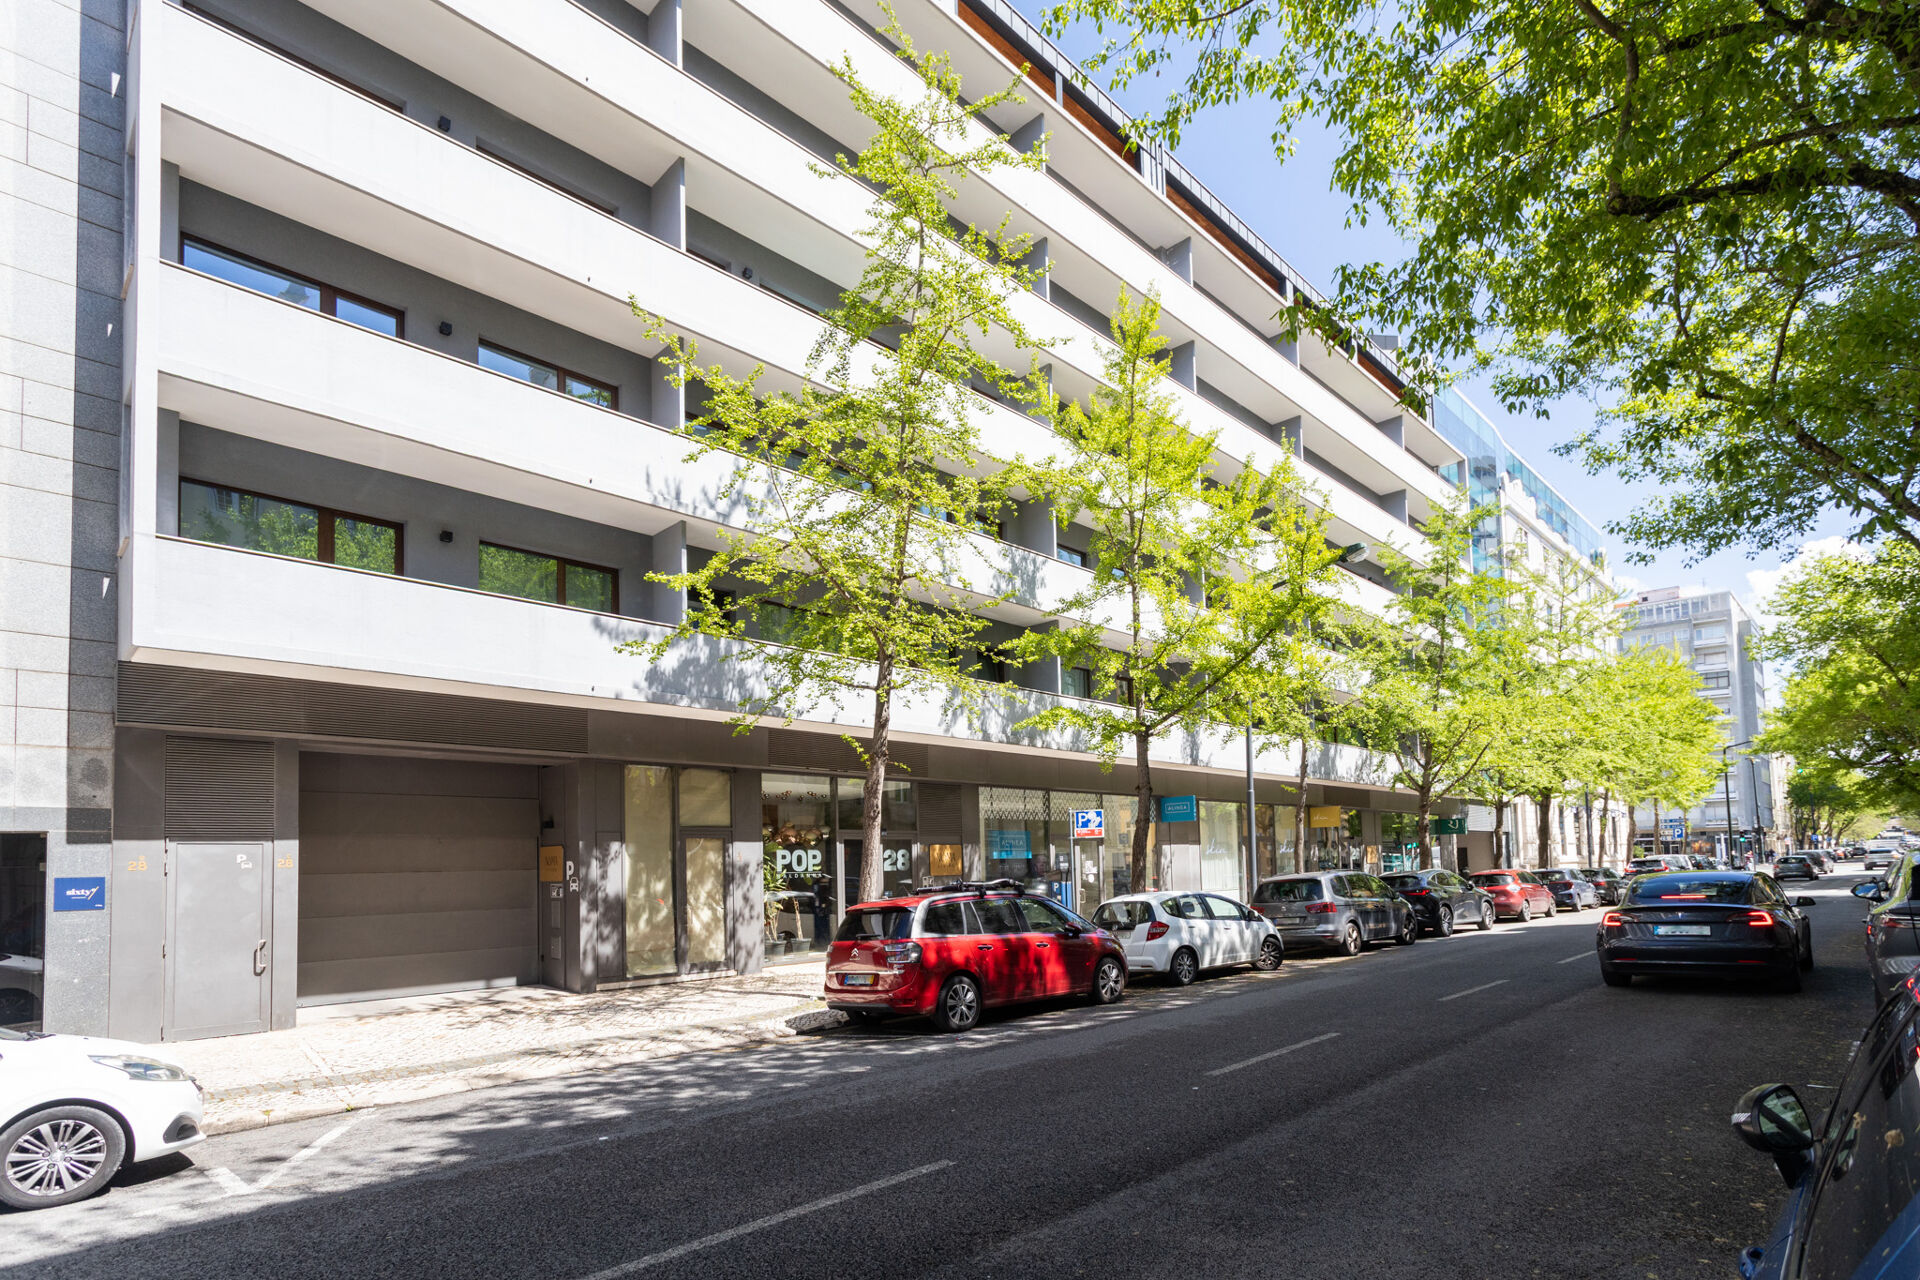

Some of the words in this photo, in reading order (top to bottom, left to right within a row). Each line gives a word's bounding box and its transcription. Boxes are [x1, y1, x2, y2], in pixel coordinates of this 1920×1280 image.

[1078, 813, 1088, 827] P
[1674, 829, 1682, 838] P
[236, 854, 247, 864] P
[776, 849, 822, 872] POP
[883, 849, 910, 871] 28
[127, 860, 149, 871] 28
[566, 860, 575, 881] P
[1053, 882, 1060, 892] P
